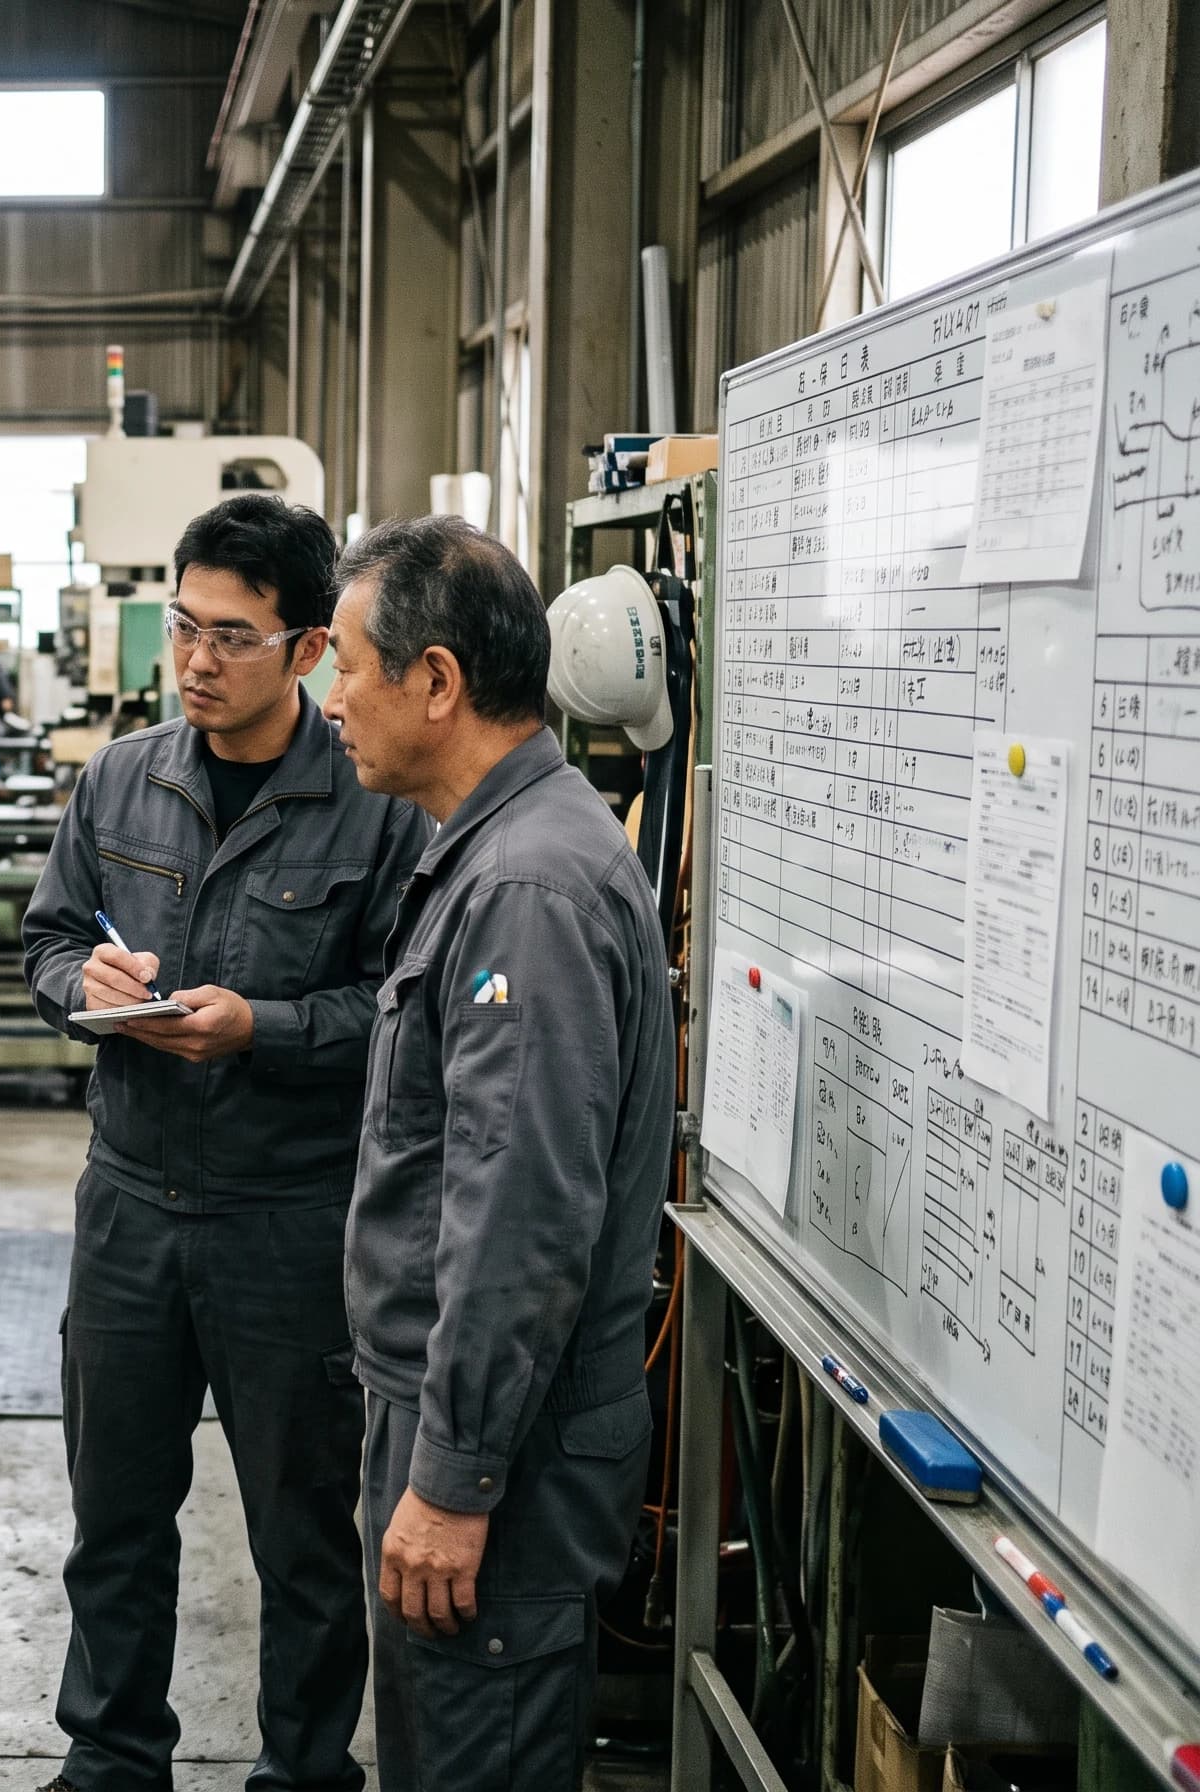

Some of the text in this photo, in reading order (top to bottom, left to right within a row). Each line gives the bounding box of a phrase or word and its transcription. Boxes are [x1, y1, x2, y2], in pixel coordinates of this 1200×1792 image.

[1098, 743, 1105, 768] 6
[1096, 788, 1103, 815] 7
[1093, 837, 1101, 861] 8
[1091, 882, 1099, 907] 9
[1088, 929, 1099, 956] 11
[1086, 976, 1099, 1002] 14
[1081, 1112, 1089, 1137] 2
[1079, 1158, 1087, 1183] 3
[1078, 1204, 1085, 1228] 6
[1073, 1248, 1086, 1275] 10
[1071, 1296, 1083, 1321] 12
[1069, 1339, 1082, 1366] 17
